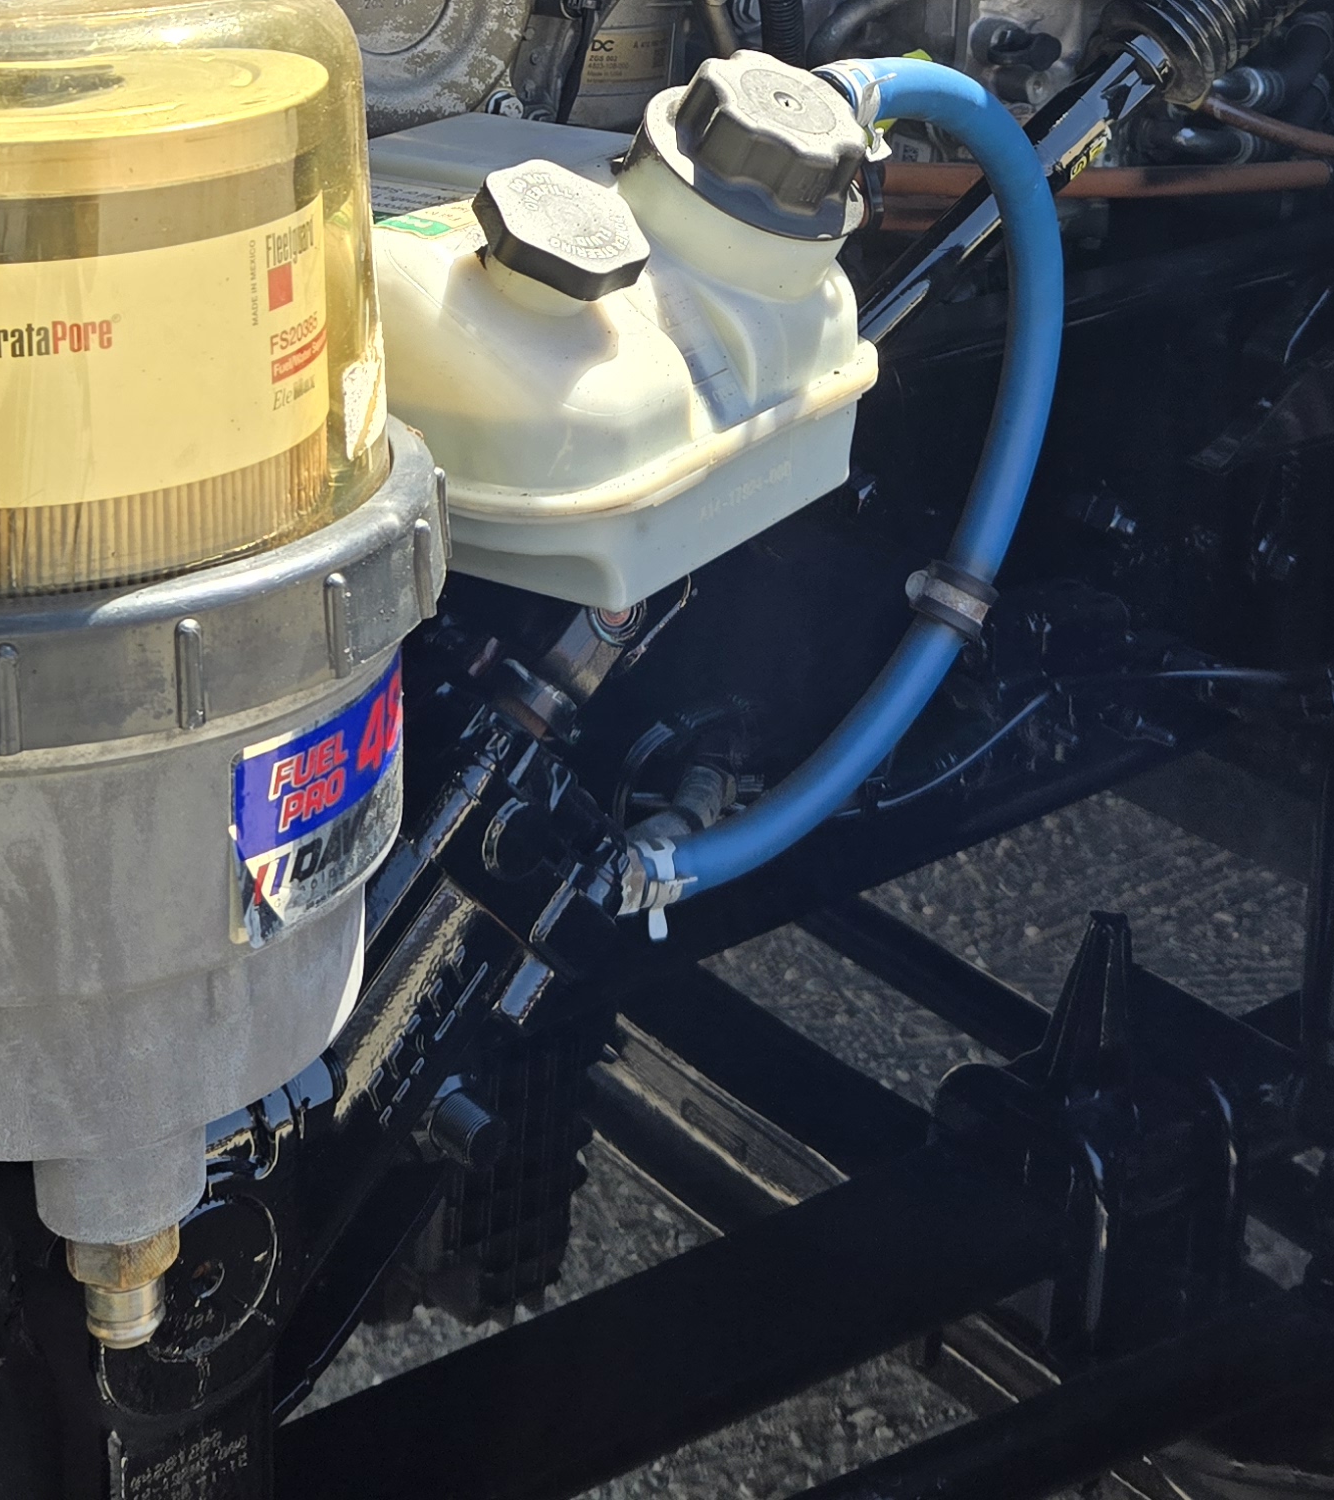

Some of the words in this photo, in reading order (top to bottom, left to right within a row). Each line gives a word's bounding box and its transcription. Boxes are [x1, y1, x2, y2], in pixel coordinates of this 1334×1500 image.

[523, 172, 552, 185] NOT
[575, 227, 612, 246] FLUID
[250, 283, 258, 293] IN
[251, 295, 259, 326] MADE
[268, 730, 349, 801] FUEL
[278, 767, 345, 833] PRO
